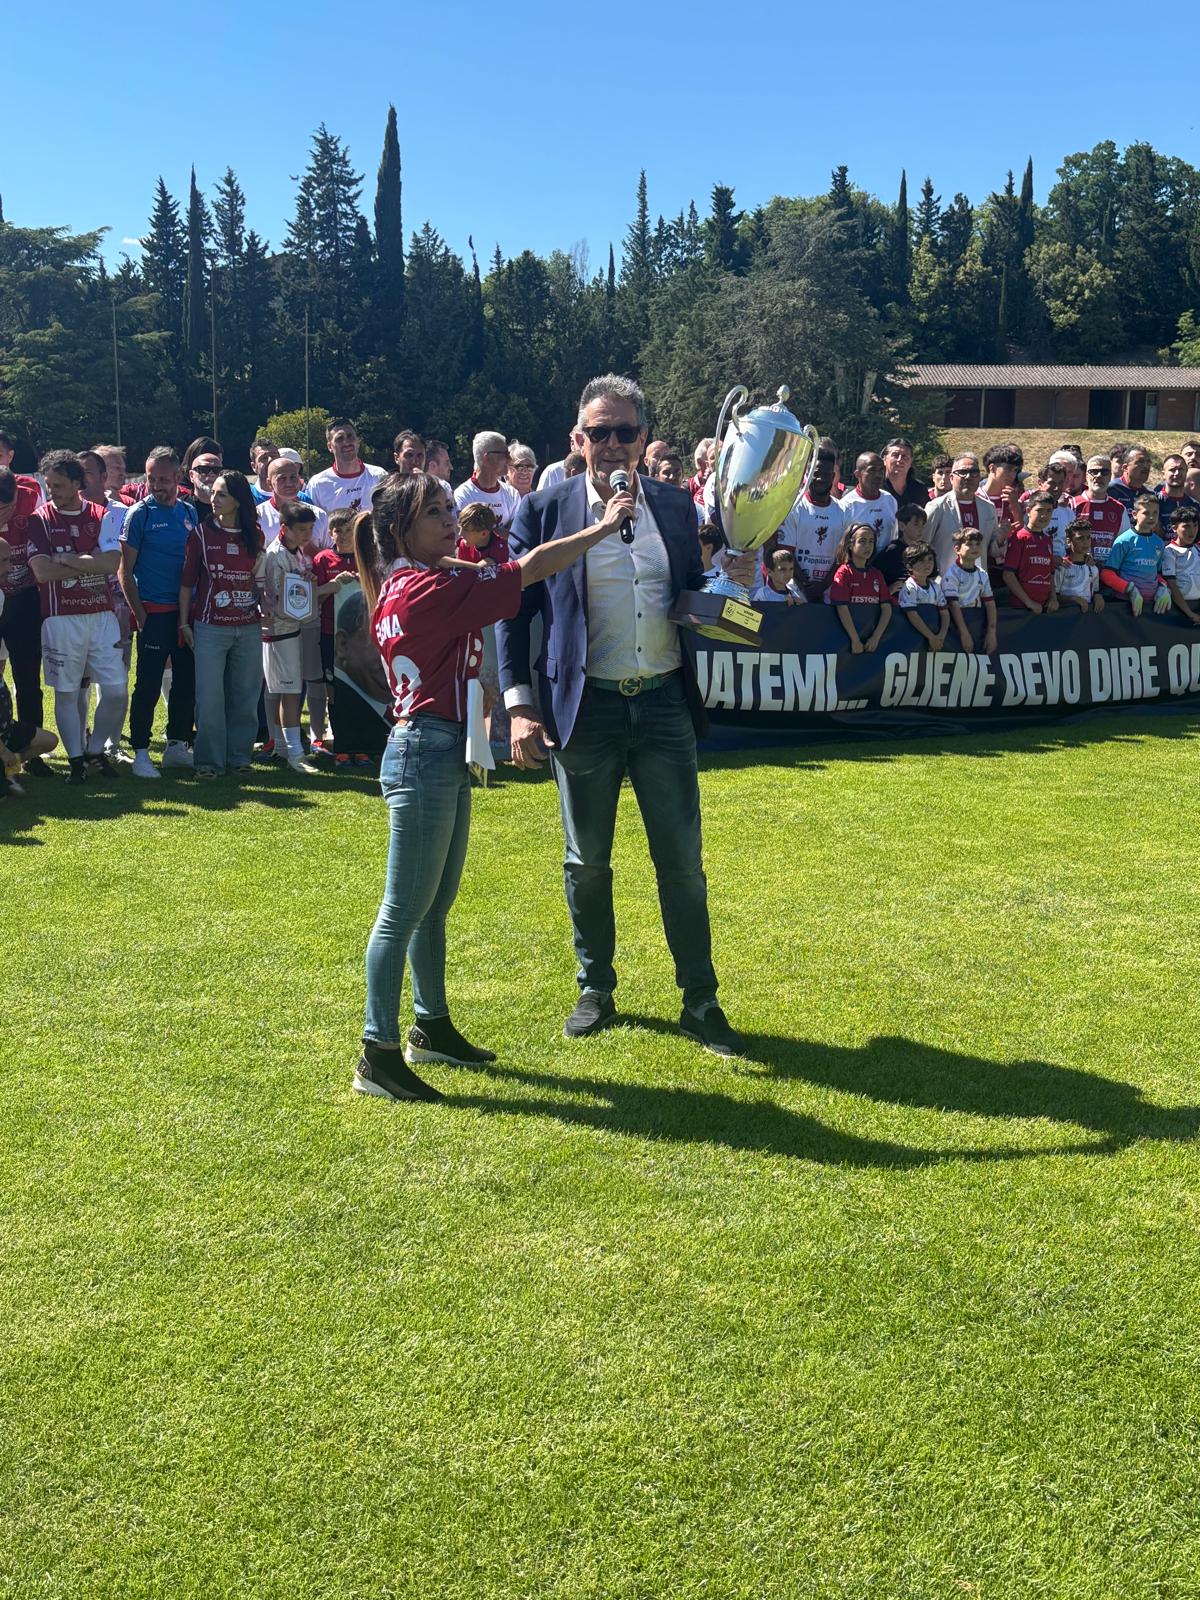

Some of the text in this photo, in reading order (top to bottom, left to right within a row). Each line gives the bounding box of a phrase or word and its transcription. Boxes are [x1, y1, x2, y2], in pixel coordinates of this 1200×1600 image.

[881, 652, 996, 708] GLIENE
[999, 649, 1081, 706] DEVO
[1088, 645, 1161, 703] DIRE
